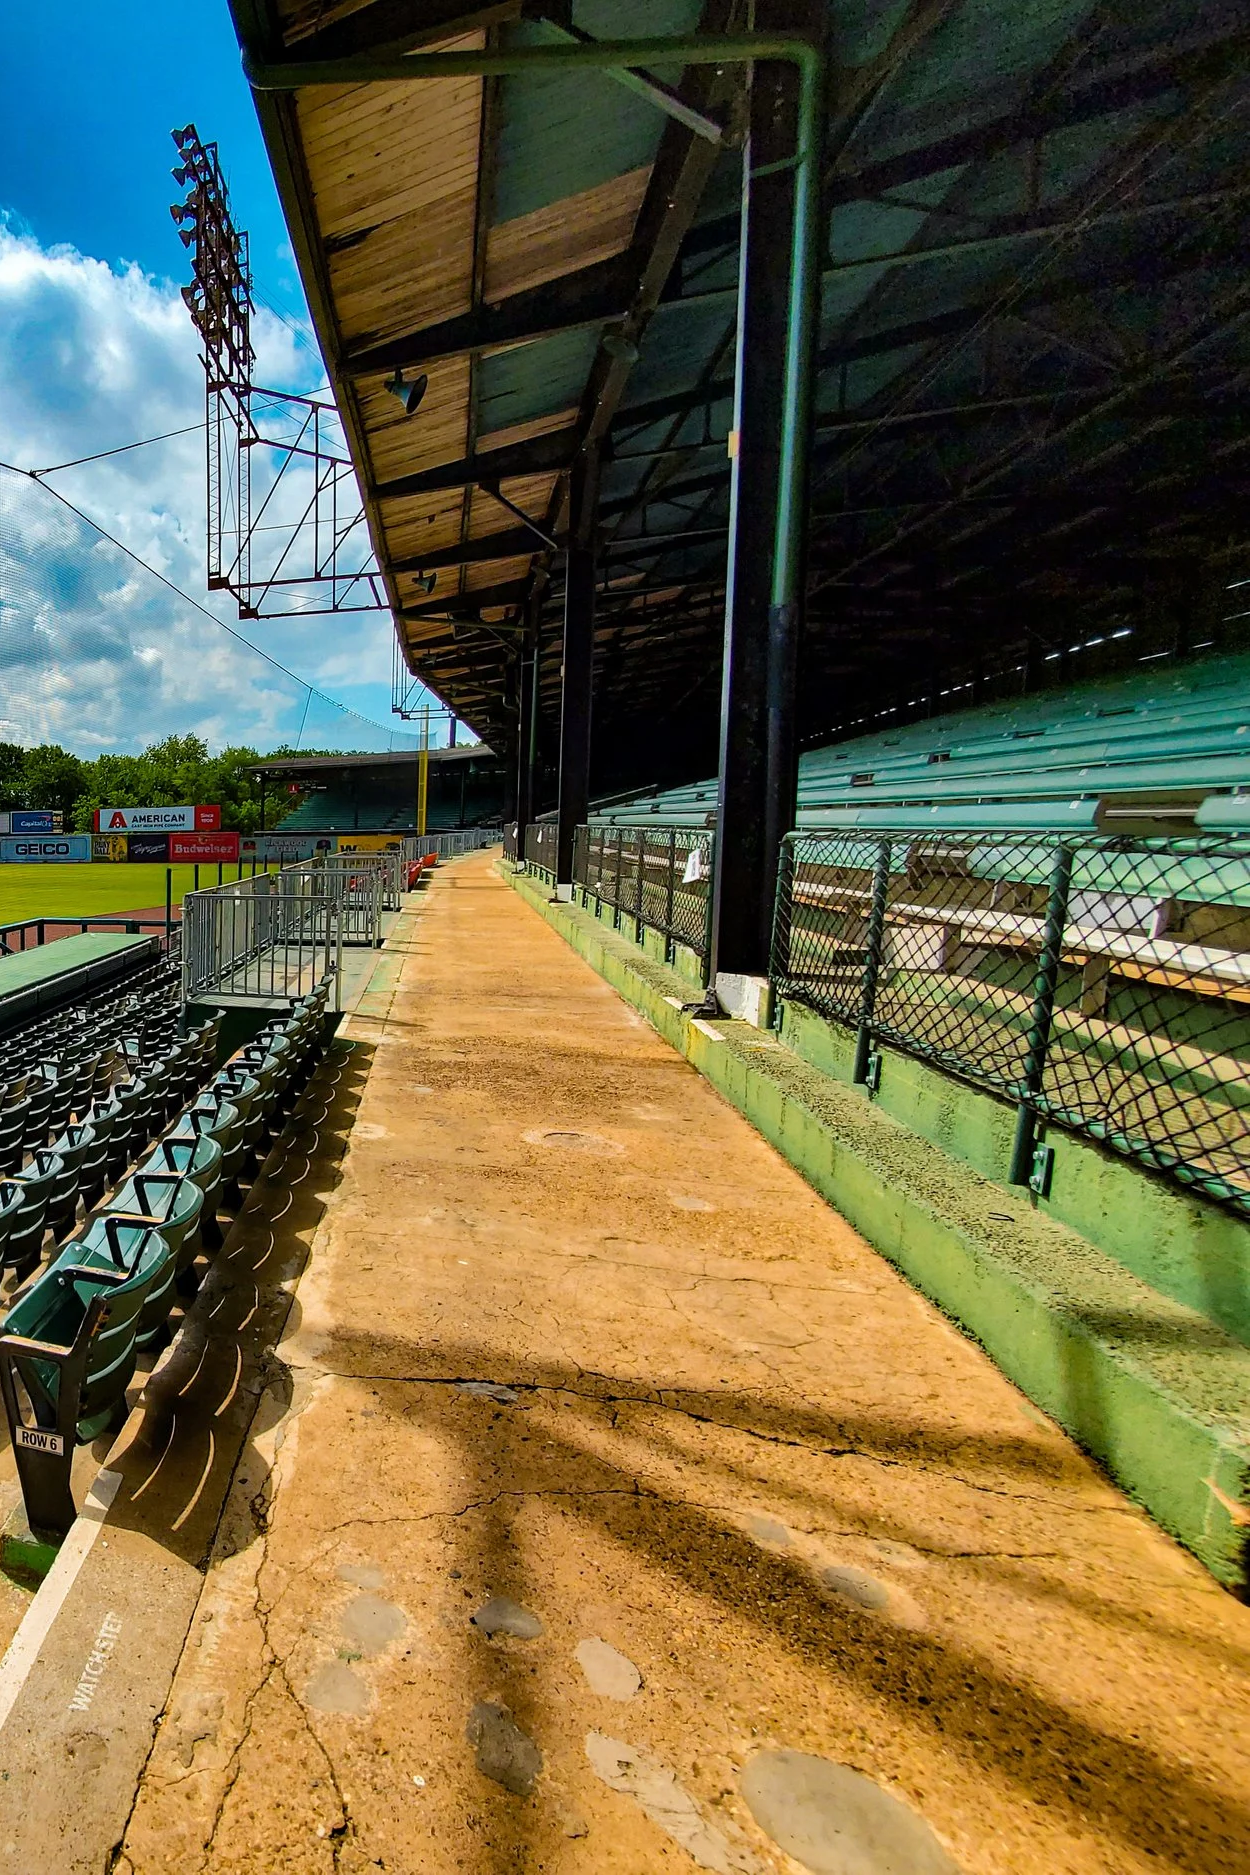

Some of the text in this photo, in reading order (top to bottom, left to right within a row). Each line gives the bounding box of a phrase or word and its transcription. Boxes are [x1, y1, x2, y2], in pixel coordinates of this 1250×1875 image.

[132, 814, 186, 824] AMERICAN
[15, 843, 70, 855] GEICO
[175, 843, 234, 854] Budweiser
[22, 1430, 58, 1451] ROW 6
[68, 1610, 124, 1712] WATCH STEP
